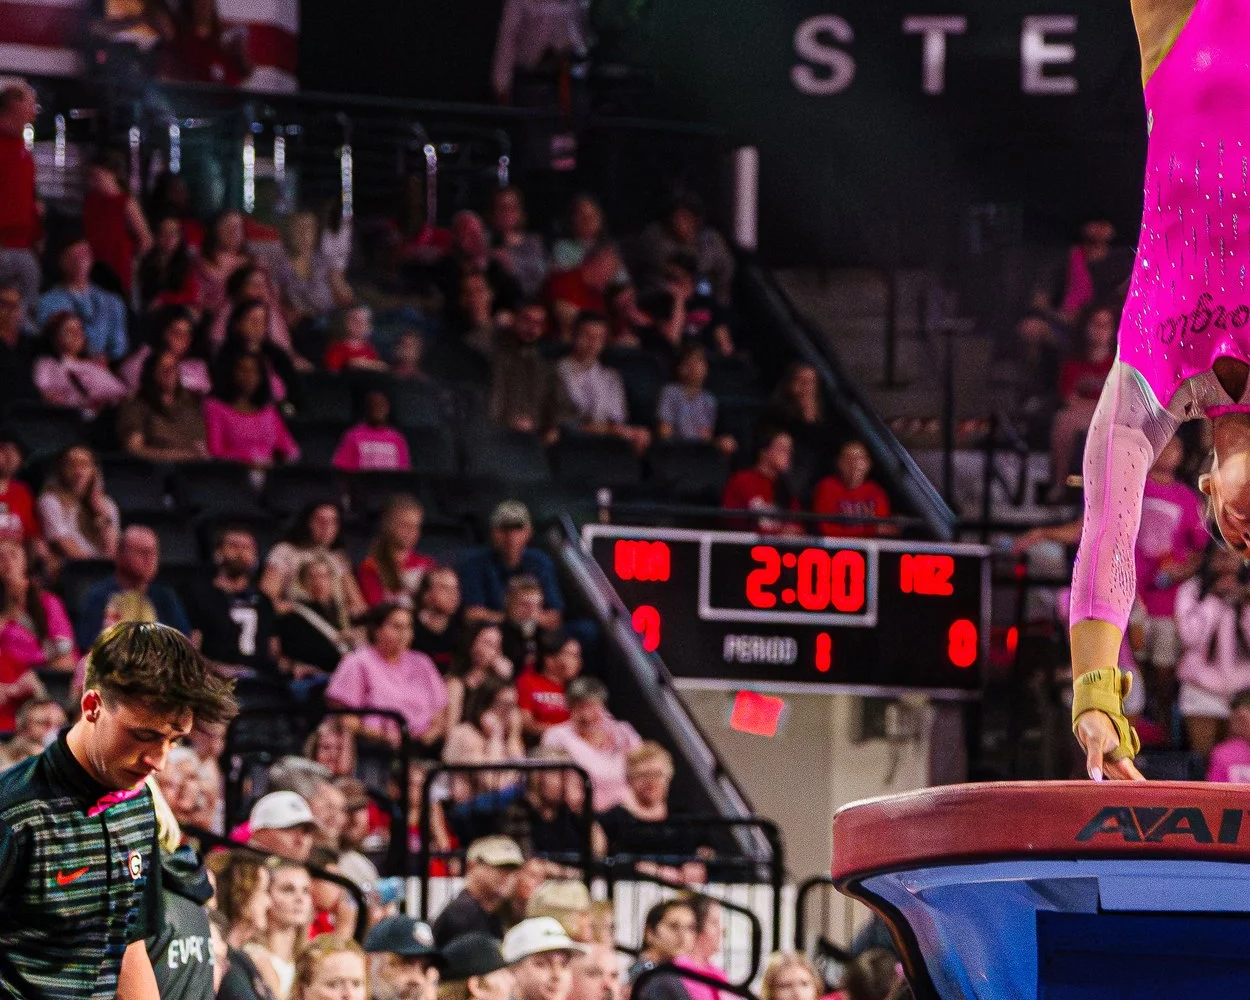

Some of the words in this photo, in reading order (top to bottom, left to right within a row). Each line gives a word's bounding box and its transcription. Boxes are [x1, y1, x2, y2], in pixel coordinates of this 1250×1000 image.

[746, 545, 866, 612] 2:00
[230, 607, 258, 656] 7
[815, 631, 832, 673] 1
[948, 618, 978, 668] 0
